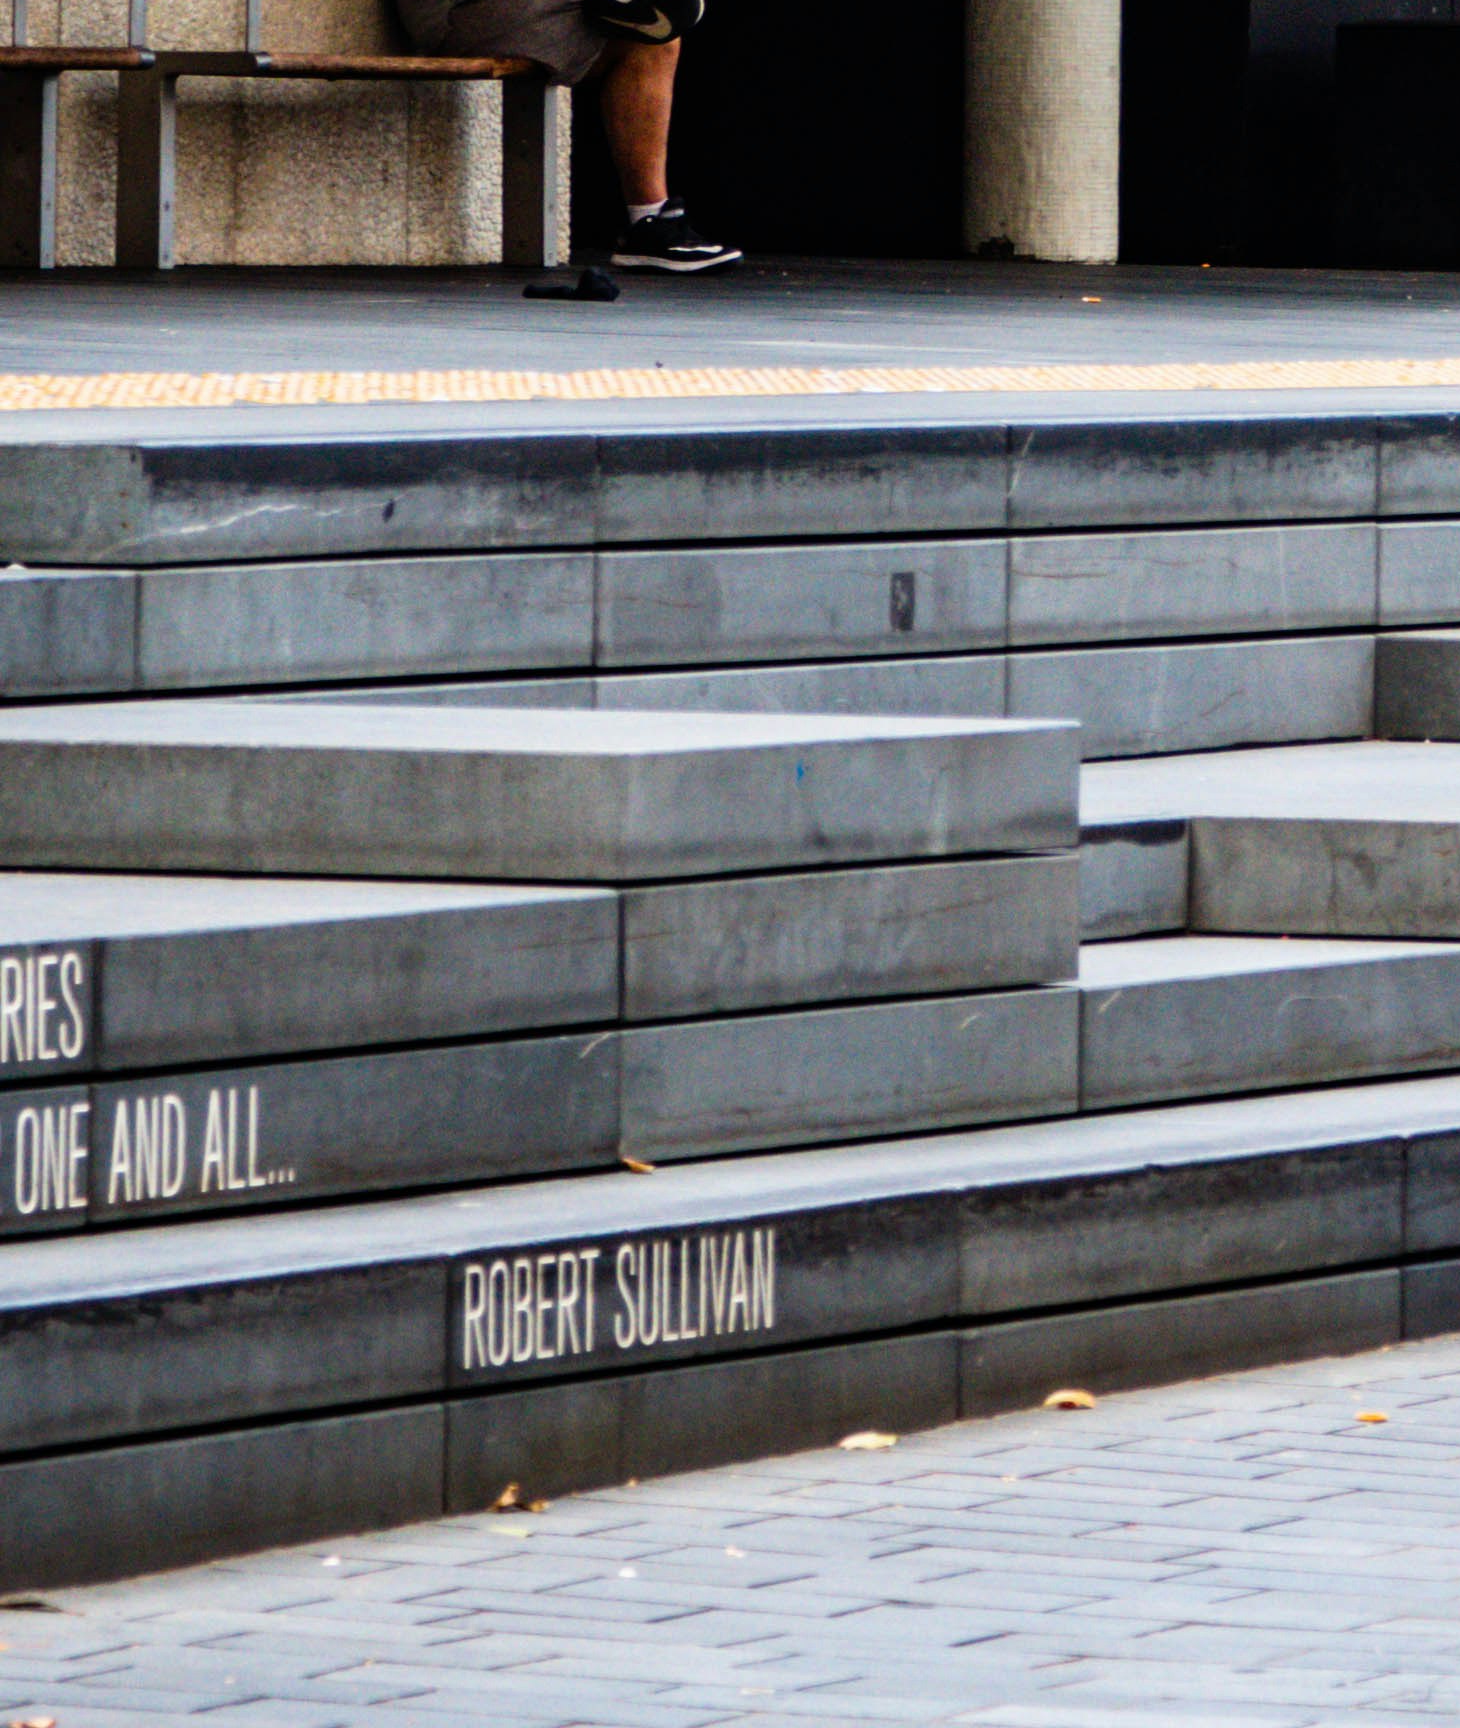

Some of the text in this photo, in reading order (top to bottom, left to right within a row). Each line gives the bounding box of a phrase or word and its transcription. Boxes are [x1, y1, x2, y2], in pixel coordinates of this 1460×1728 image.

[0, 952, 84, 1063] RIES
[15, 1085, 296, 1215] ONE AND ALL...
[462, 1228, 777, 1370] ROBERT SULLIVAN
